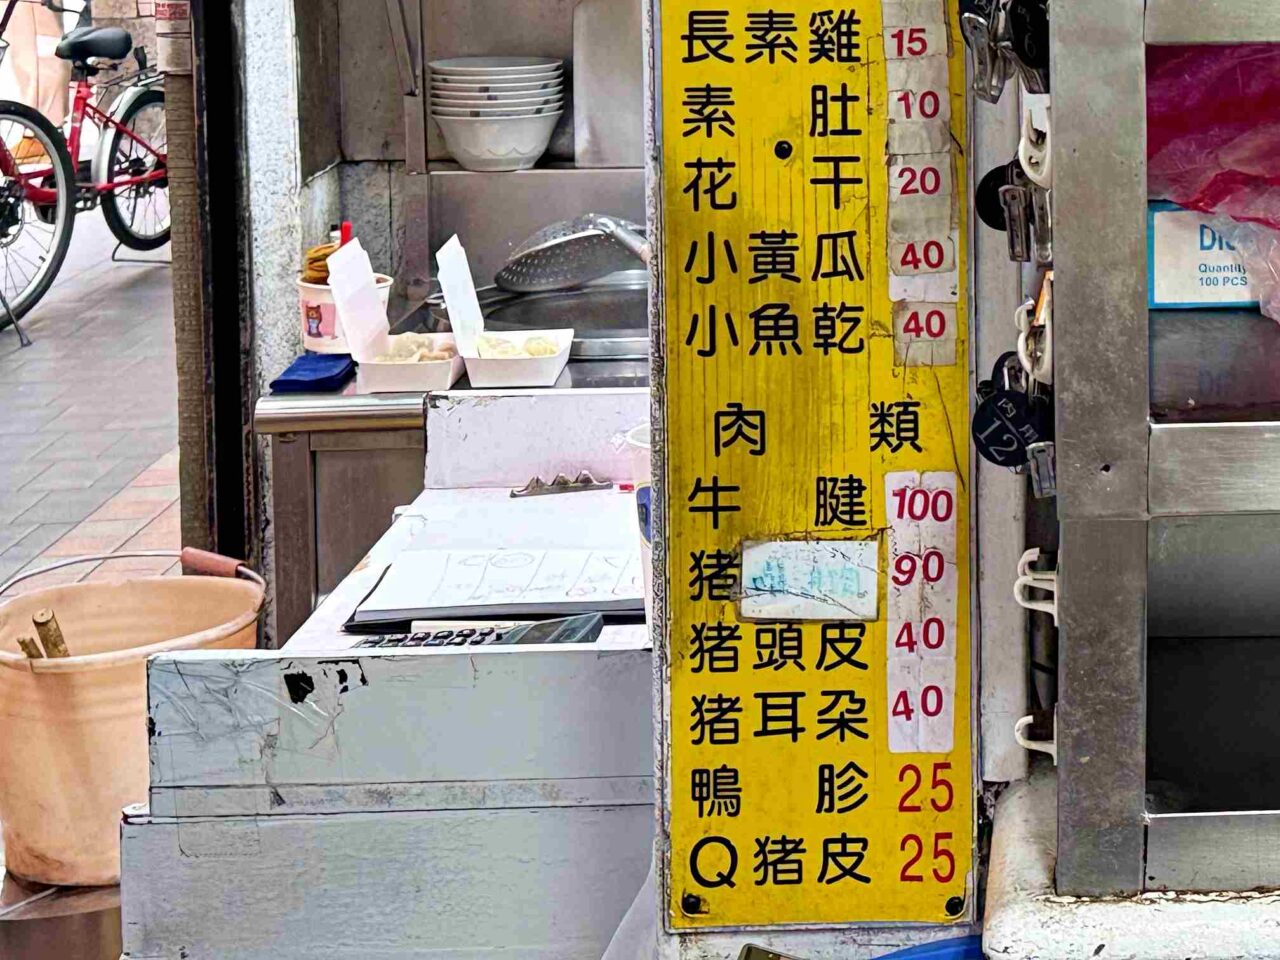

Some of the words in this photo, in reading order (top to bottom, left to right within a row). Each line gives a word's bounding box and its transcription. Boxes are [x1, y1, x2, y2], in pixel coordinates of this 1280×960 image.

[680, 9, 862, 64] 長素雞
[890, 28, 928, 57] 15
[682, 83, 863, 138] 素肚
[897, 91, 940, 119] 10
[898, 167, 941, 195] 20
[684, 229, 865, 285] 小黃瓜
[900, 240, 944, 270] 40
[1199, 276, 1219, 287] 100
[1222, 276, 1248, 286] PCS
[685, 302, 865, 358] 小魚乾
[902, 310, 946, 338] 40
[891, 488, 953, 522] 100
[892, 550, 945, 586] 90
[895, 617, 945, 653] 40
[892, 685, 944, 721] 40
[898, 762, 954, 813] 25
[900, 832, 956, 883] 25
